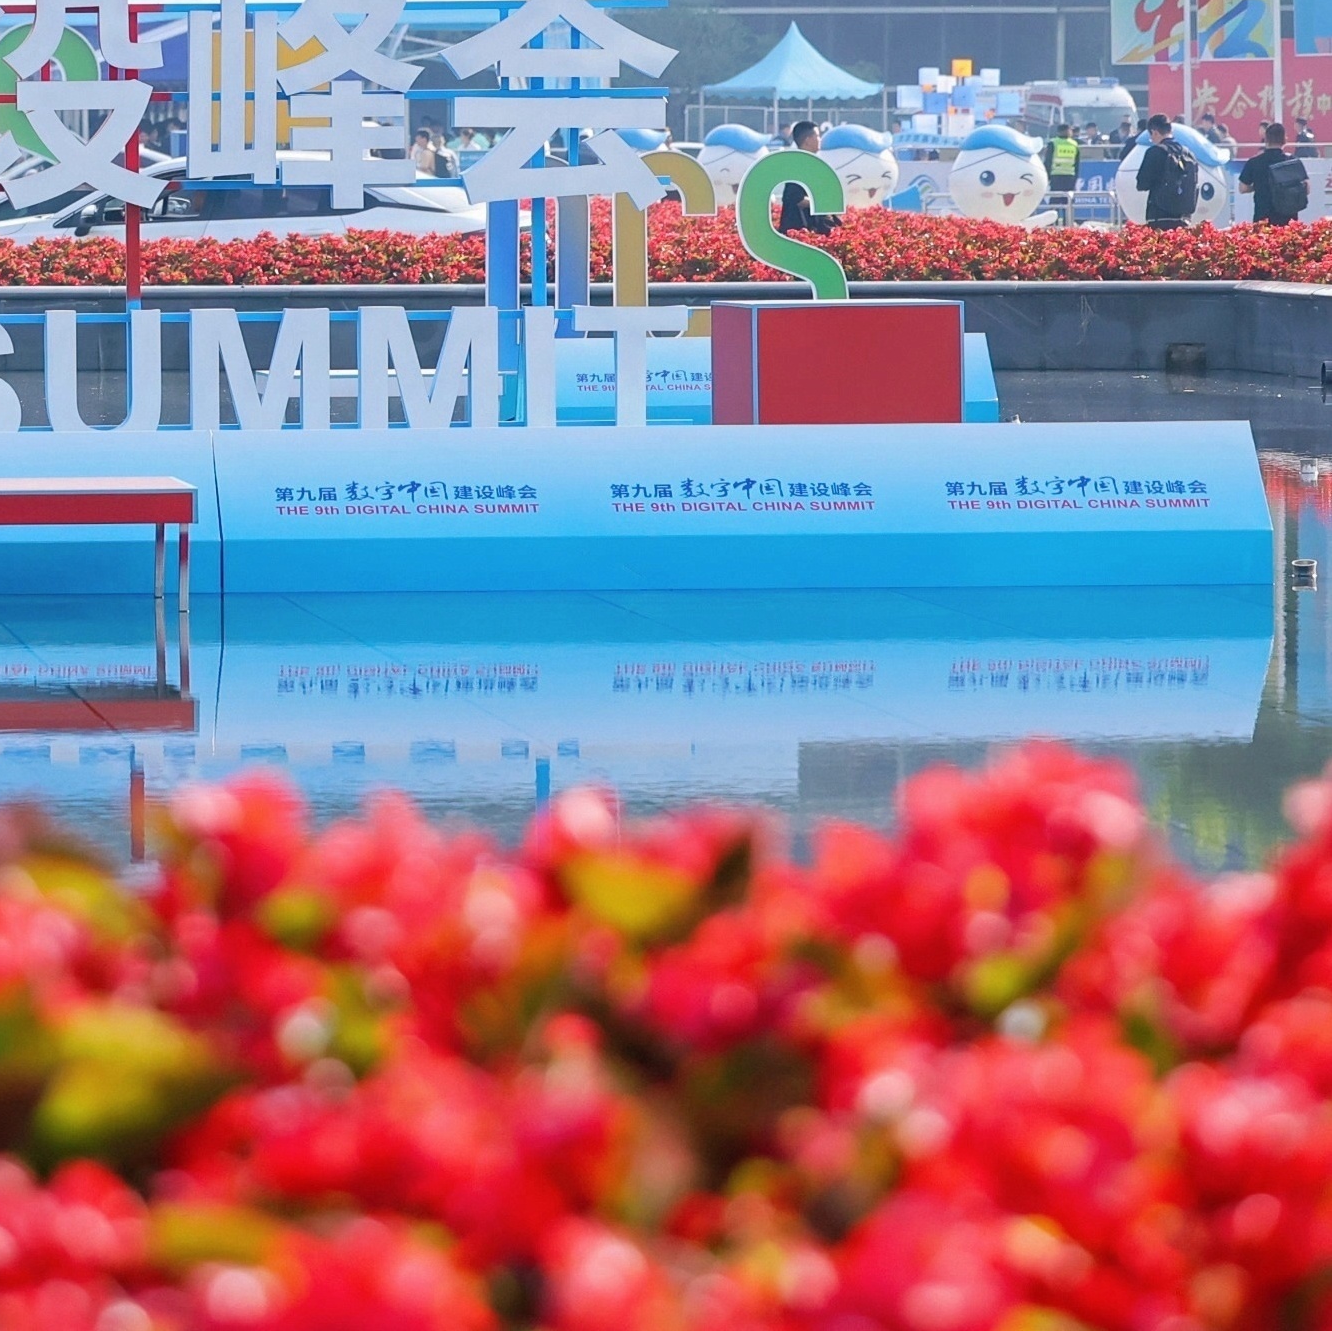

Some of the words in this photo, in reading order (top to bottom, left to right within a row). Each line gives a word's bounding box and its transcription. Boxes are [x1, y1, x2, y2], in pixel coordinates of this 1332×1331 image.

[274, 479, 538, 502] 第九届数字中国建设峰会
[610, 478, 873, 500] 第九届数字中国建设峰会
[945, 475, 1208, 497] 第九届数字中国建设峰会
[275, 505, 310, 516] THE
[314, 505, 340, 516] 9th
[345, 504, 412, 515] DIGITAL
[416, 504, 470, 515] CHINA
[473, 503, 540, 514] SUMMIT
[611, 502, 646, 513] THE
[650, 502, 676, 513] 9th
[680, 501, 748, 512] DIGITAL
[752, 501, 806, 512] CHINA
[809, 500, 876, 512] SUMMIT
[946, 499, 982, 510] THE
[985, 499, 1012, 510] 9th
[1016, 499, 1084, 510] DIGITAL
[1087, 498, 1142, 509] CHINA
[1144, 498, 1211, 509] SUMMIT
